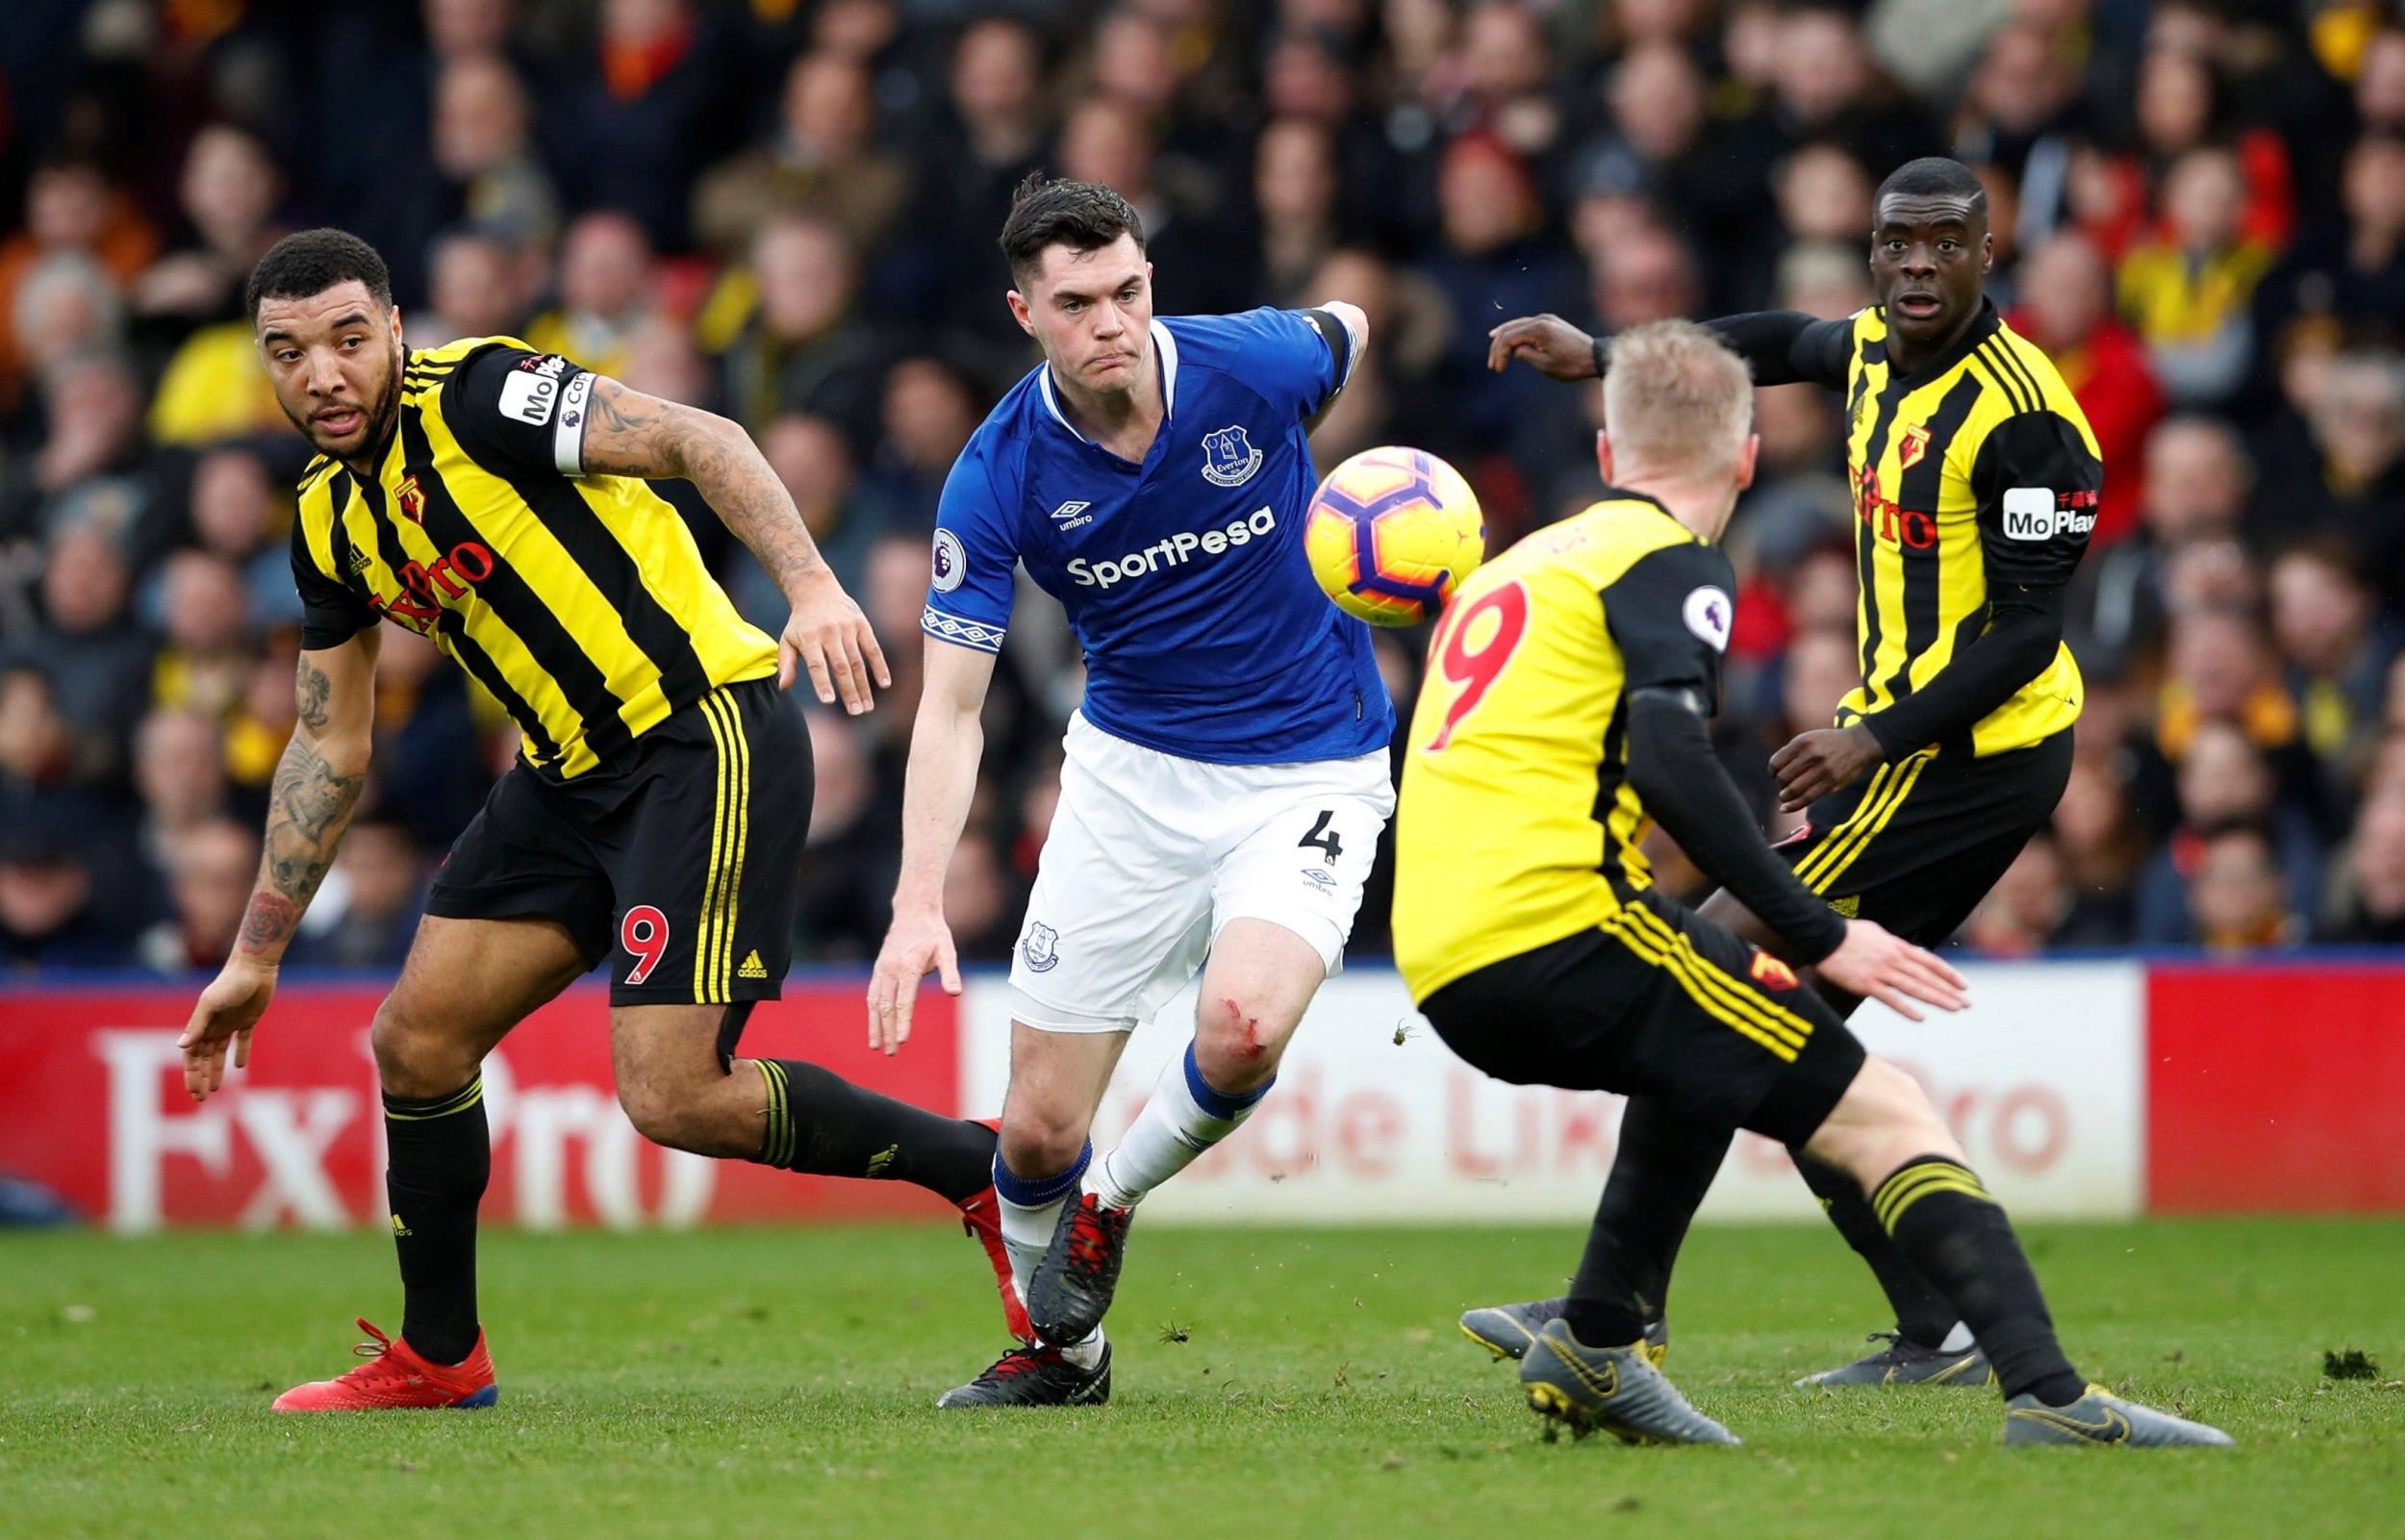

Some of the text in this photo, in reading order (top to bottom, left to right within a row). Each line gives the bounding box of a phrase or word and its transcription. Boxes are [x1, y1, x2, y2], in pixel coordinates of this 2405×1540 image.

[1216, 457, 1249, 473] Everton
[1059, 514, 1093, 531] umbro
[1067, 505, 1277, 590] SportPesa
[1298, 810, 1344, 867] 4
[1303, 880, 1332, 897] umbro
[620, 904, 670, 985] 9
[737, 969, 768, 978] adidas
